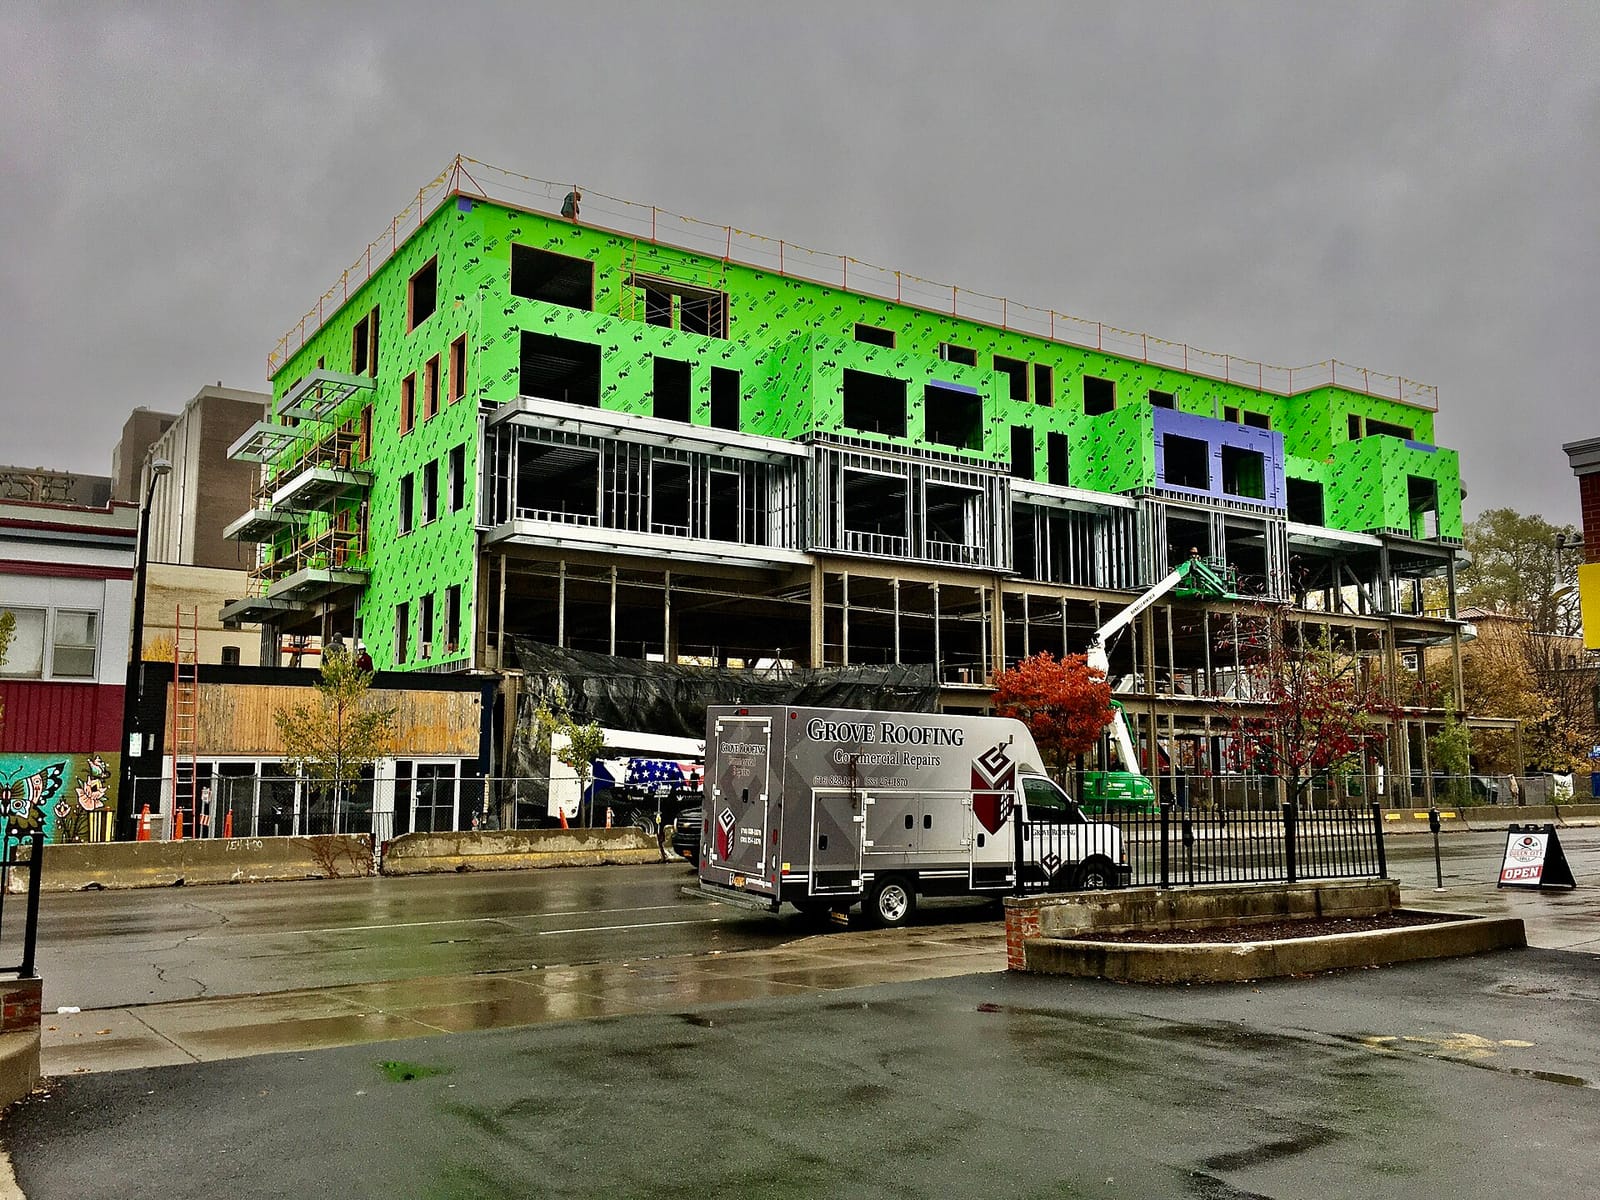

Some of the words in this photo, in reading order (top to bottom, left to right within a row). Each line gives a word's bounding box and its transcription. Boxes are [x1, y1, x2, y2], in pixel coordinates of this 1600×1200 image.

[462, 263, 472, 271] USG
[502, 330, 512, 340] USG
[485, 338, 495, 347] USG
[502, 372, 512, 382] USG
[485, 380, 495, 388] USG
[601, 389, 610, 398] USG
[806, 718, 875, 744] GROVE
[880, 722, 964, 746] ROOFING
[902, 752, 941, 769] Repairs
[1504, 866, 1539, 879] OPEN
